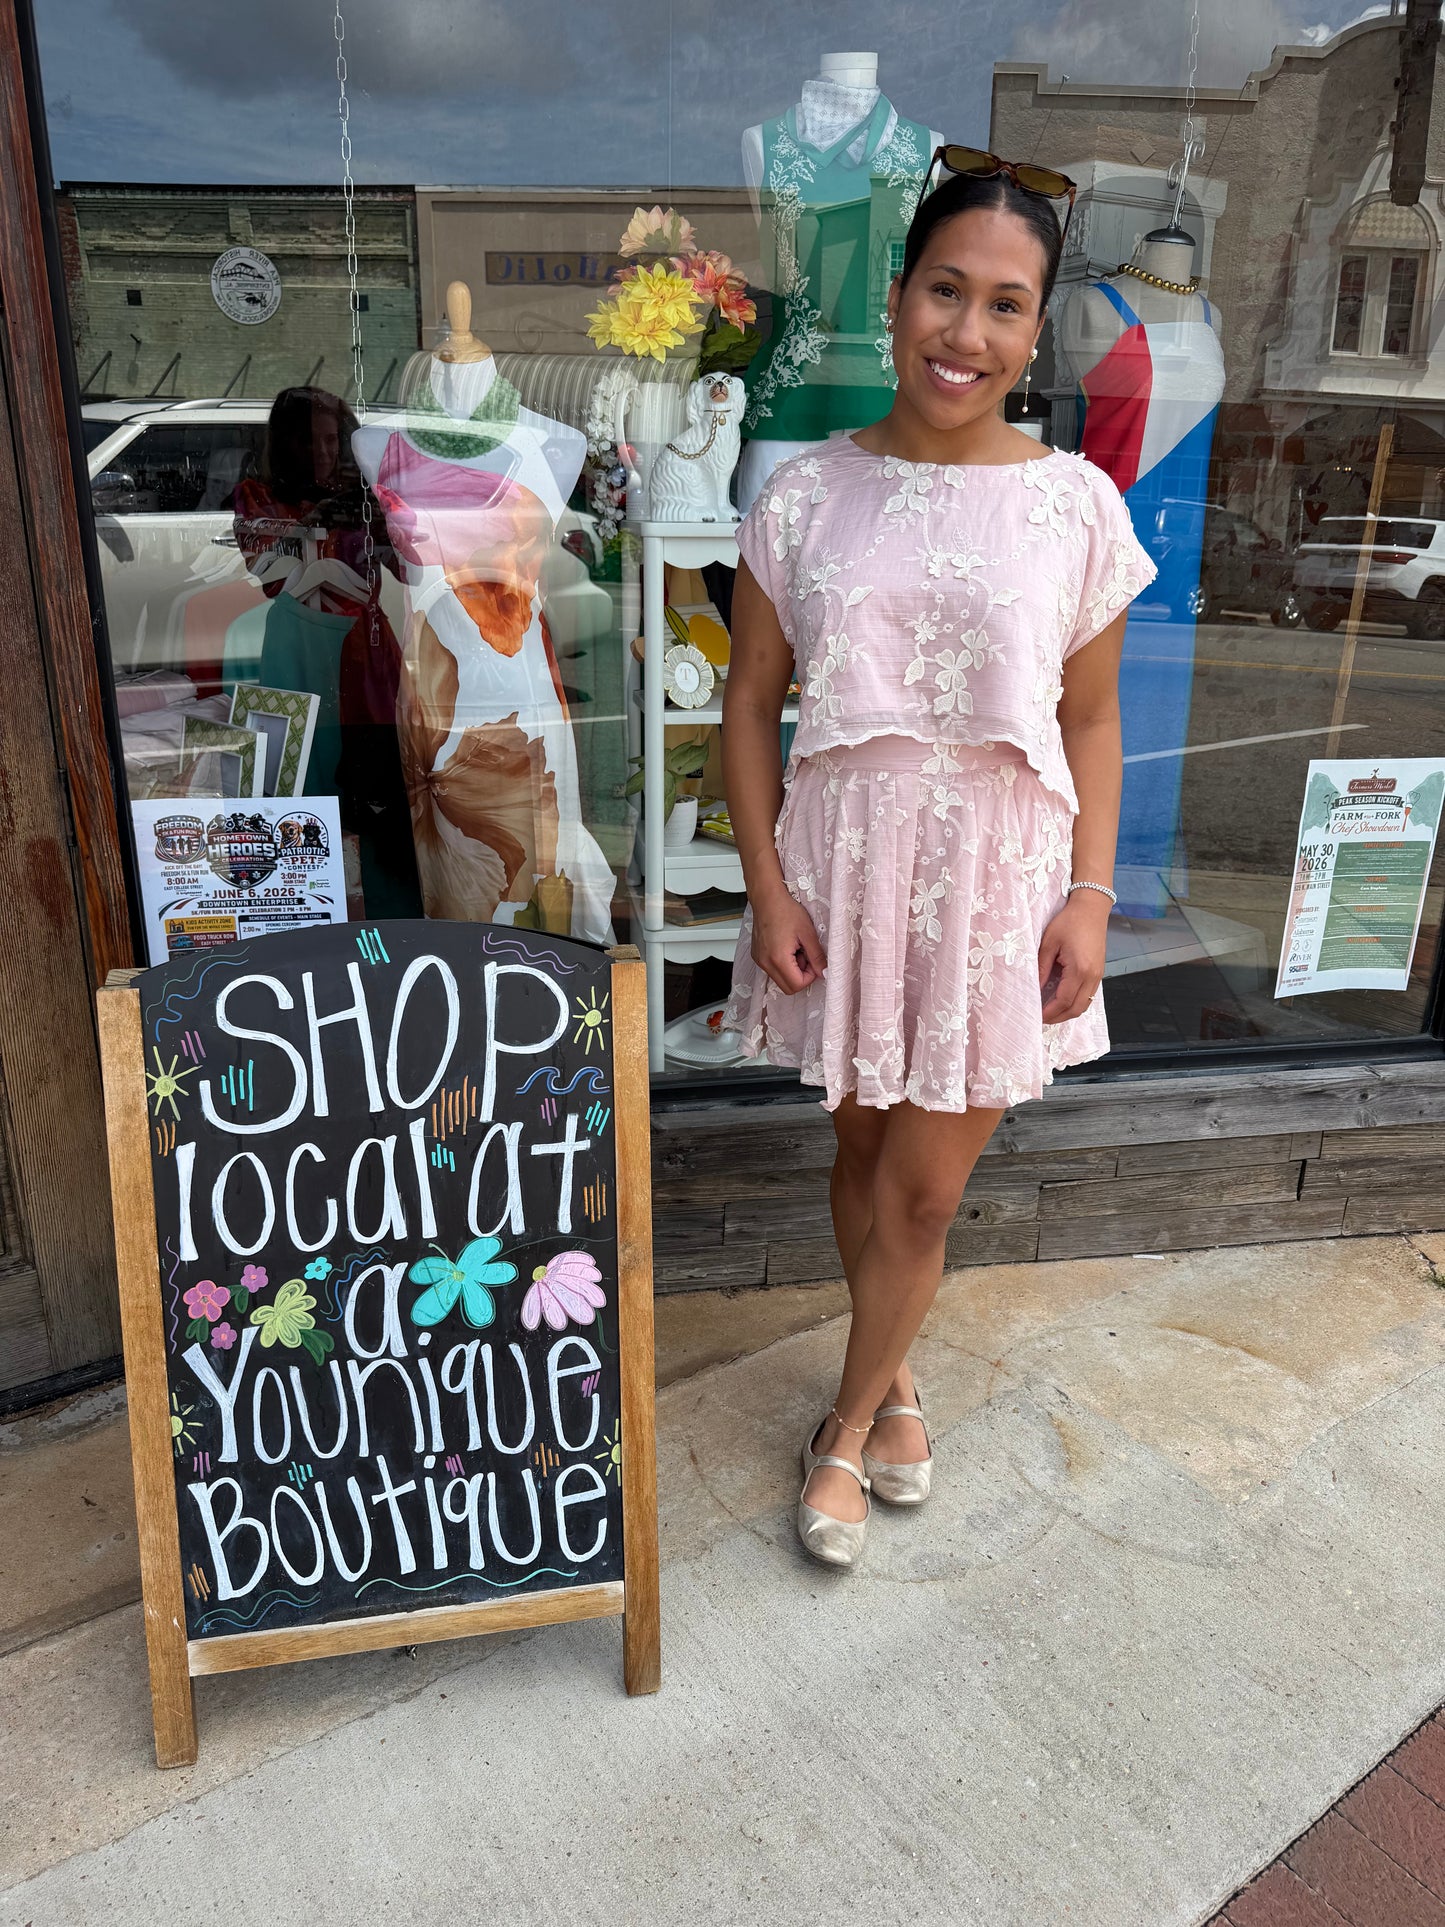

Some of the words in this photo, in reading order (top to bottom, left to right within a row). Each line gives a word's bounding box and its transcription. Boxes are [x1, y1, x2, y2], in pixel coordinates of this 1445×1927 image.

[1350, 781, 1373, 790] Farmers
[1338, 797, 1353, 806] PEAK
[1355, 796, 1377, 804] SEASON
[1377, 797, 1400, 805] KICKOFF
[1334, 812, 1364, 821] FARM
[1375, 811, 1401, 820] FORK
[155, 821, 203, 832] FREEDOM
[1331, 821, 1359, 836] Chef
[1355, 820, 1401, 835] Showdown
[207, 842, 276, 859] HEROES
[281, 847, 326, 856] PATRIOTIC
[1299, 844, 1319, 858] MAY
[1320, 843, 1336, 858] 30,
[290, 856, 317, 864] PET
[1301, 857, 1328, 872] 2026
[167, 877, 186, 885] 8:00
[212, 889, 244, 899] JUNE
[248, 888, 260, 899] 6,
[264, 887, 296, 897] 2026
[202, 900, 249, 908] DOWNTOWN
[251, 898, 299, 906] ENTERPRISE
[200, 955, 570, 1135] SHOP
[176, 1117, 438, 1262] local
[469, 1112, 594, 1238] at
[344, 1261, 409, 1359] a
[181, 1326, 603, 1465] Younique
[187, 1453, 608, 1601] Boutique
